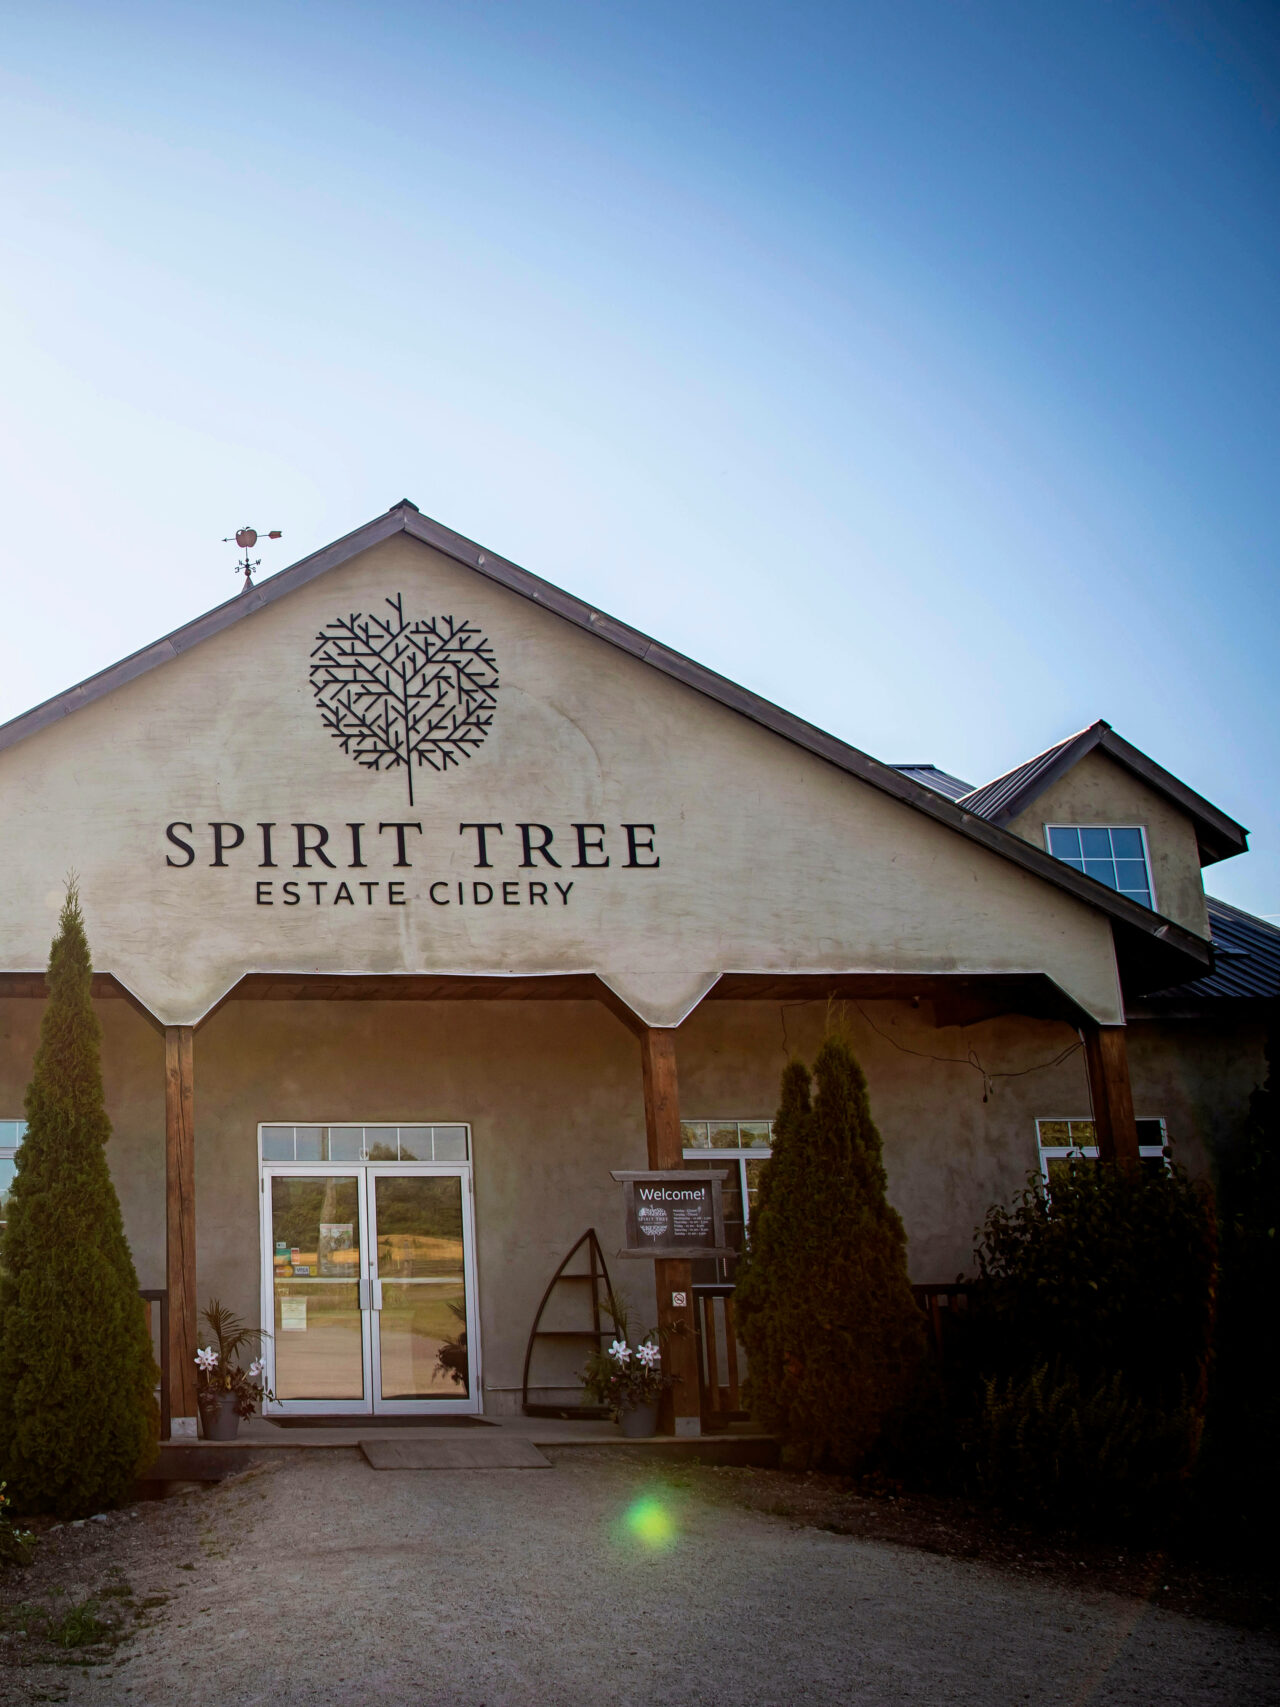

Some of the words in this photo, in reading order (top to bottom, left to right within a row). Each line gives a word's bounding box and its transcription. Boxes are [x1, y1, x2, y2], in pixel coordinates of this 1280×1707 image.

[165, 821, 423, 869] SPIRIT
[459, 822, 661, 869] TREE
[256, 881, 407, 906] ESTATE
[429, 881, 574, 906] CIDERY
[639, 1187, 705, 1201] Welcome!
